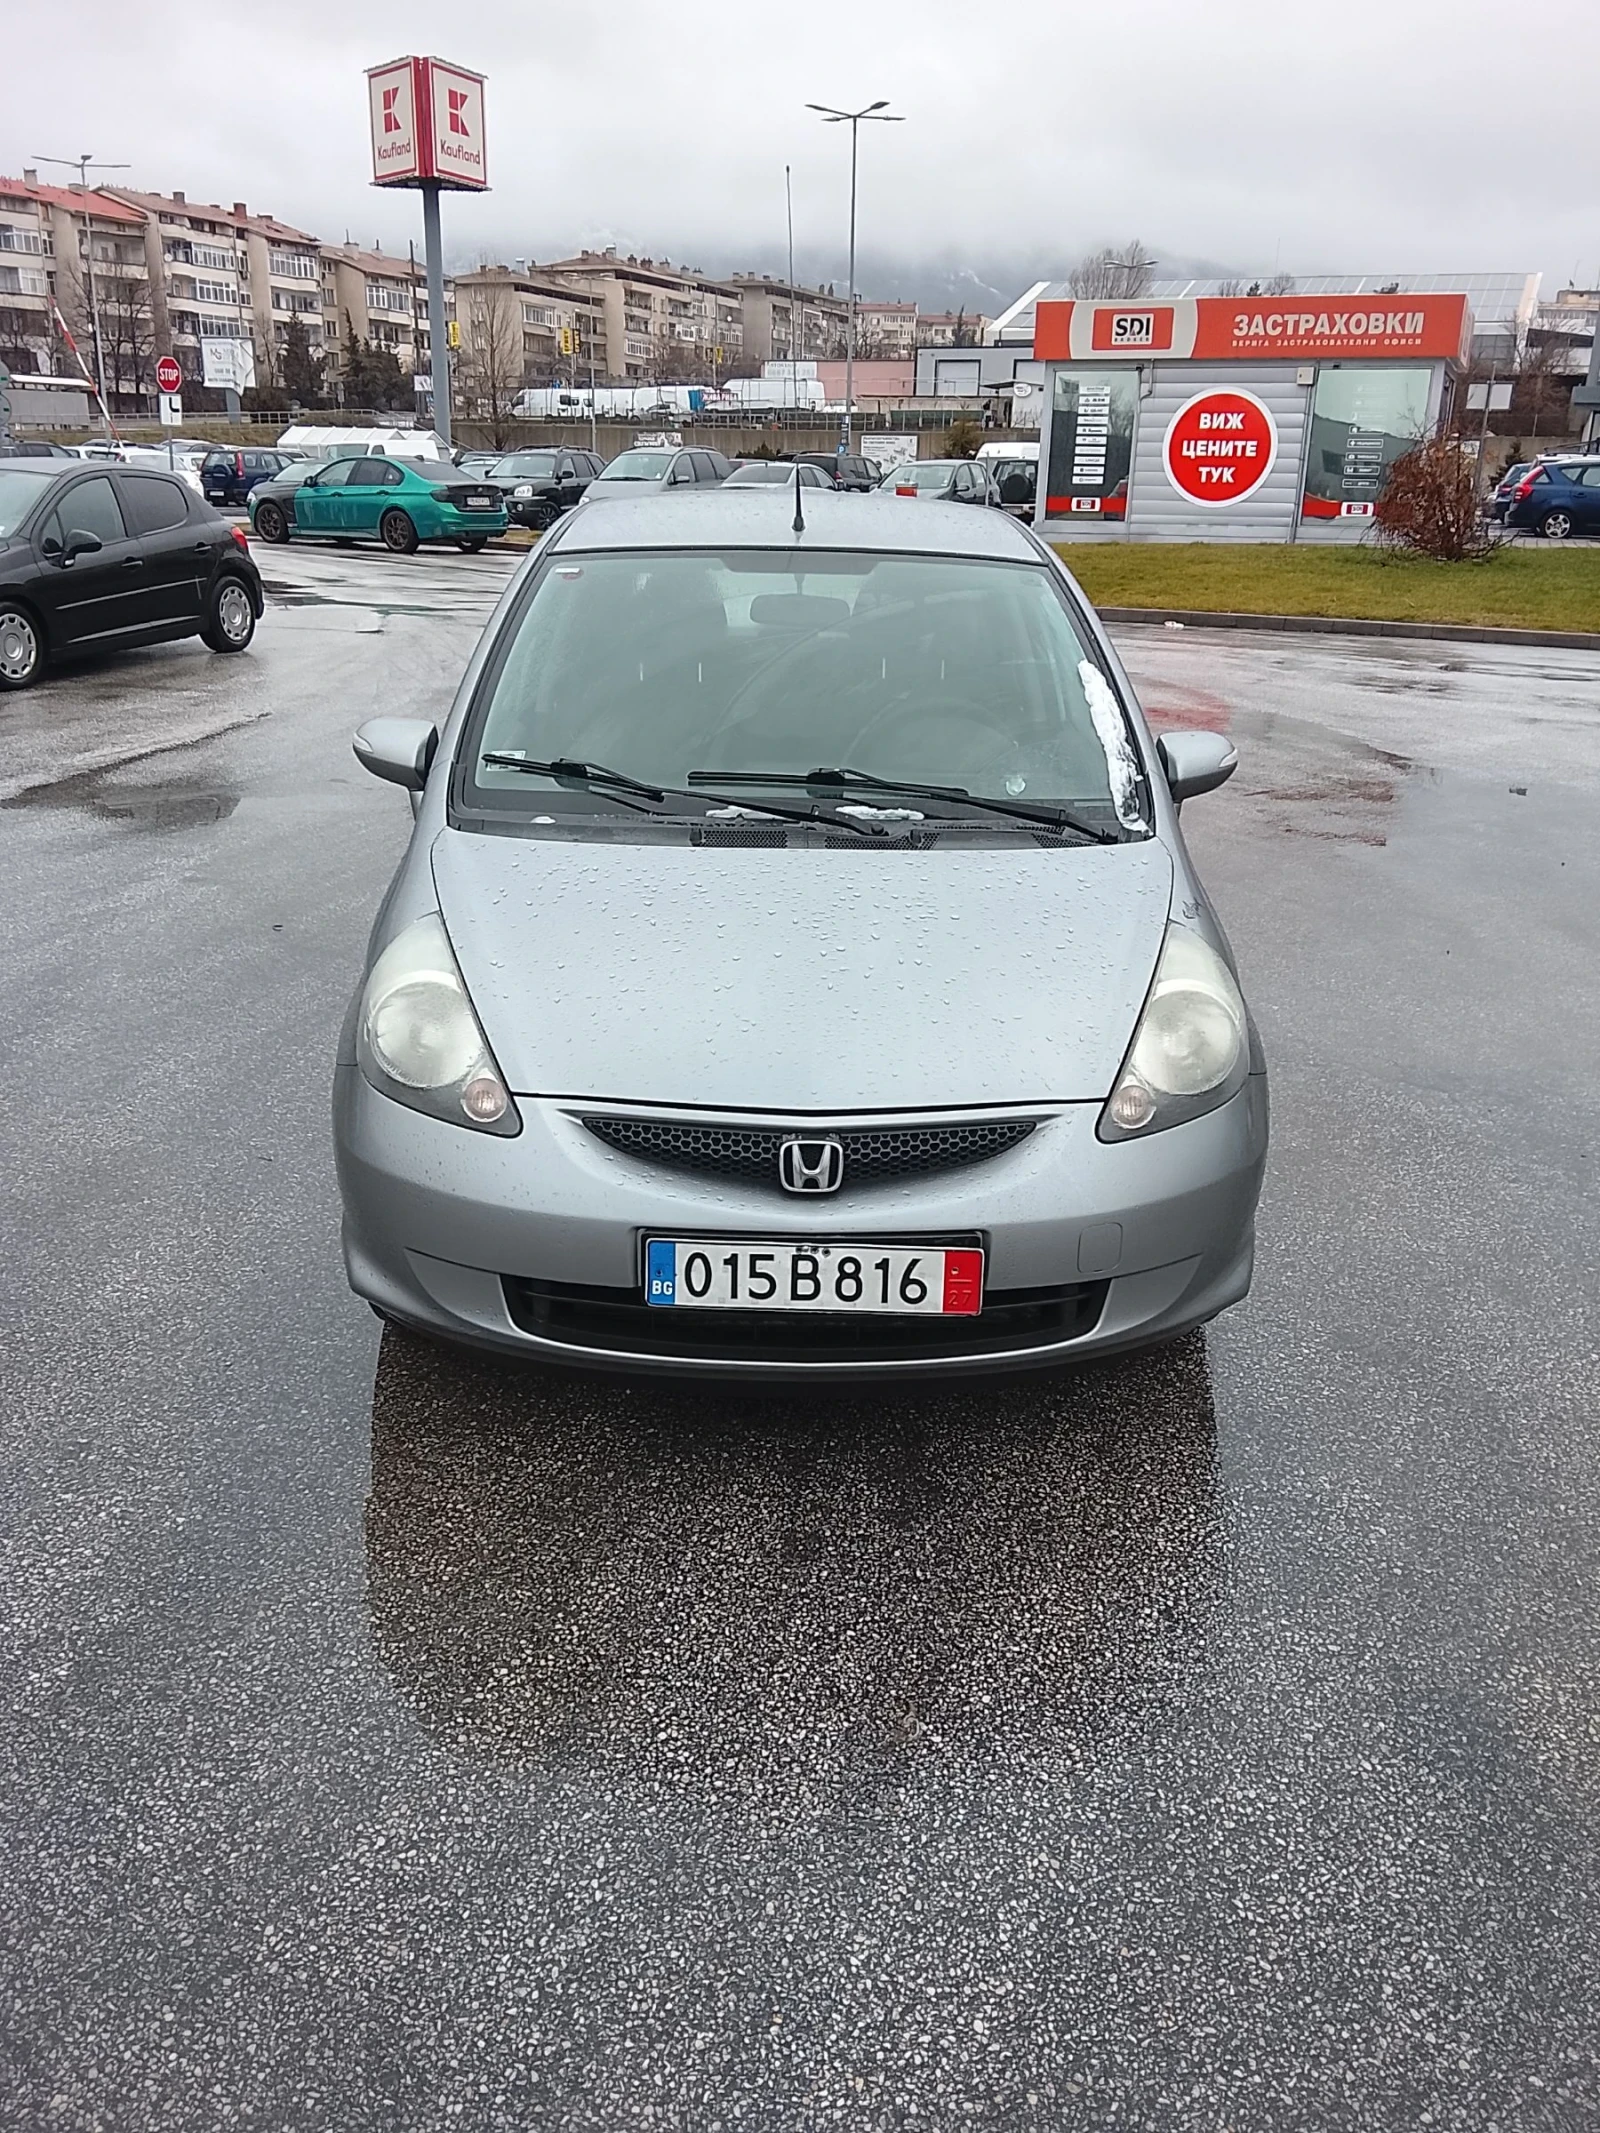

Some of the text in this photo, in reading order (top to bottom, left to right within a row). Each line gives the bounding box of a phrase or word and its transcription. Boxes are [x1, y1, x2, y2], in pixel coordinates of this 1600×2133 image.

[378, 137, 411, 160] Kaufland
[440, 138, 481, 165] Kaufland
[1115, 317, 1151, 337] SDI
[1232, 311, 1425, 336] ЗАСТРАХОВКИ
[1231, 337, 1422, 348] ВЕРИГА ЗАСТРАХОВАТЕЛНИ ОФИСИ
[159, 368, 178, 381] STOP
[1199, 412, 1246, 430] ВИЖ
[1181, 440, 1259, 459] ЦЕНИТЕ
[1198, 466, 1236, 484] ТУК
[651, 1279, 674, 1295] BG
[684, 1251, 928, 1305] 015B816
